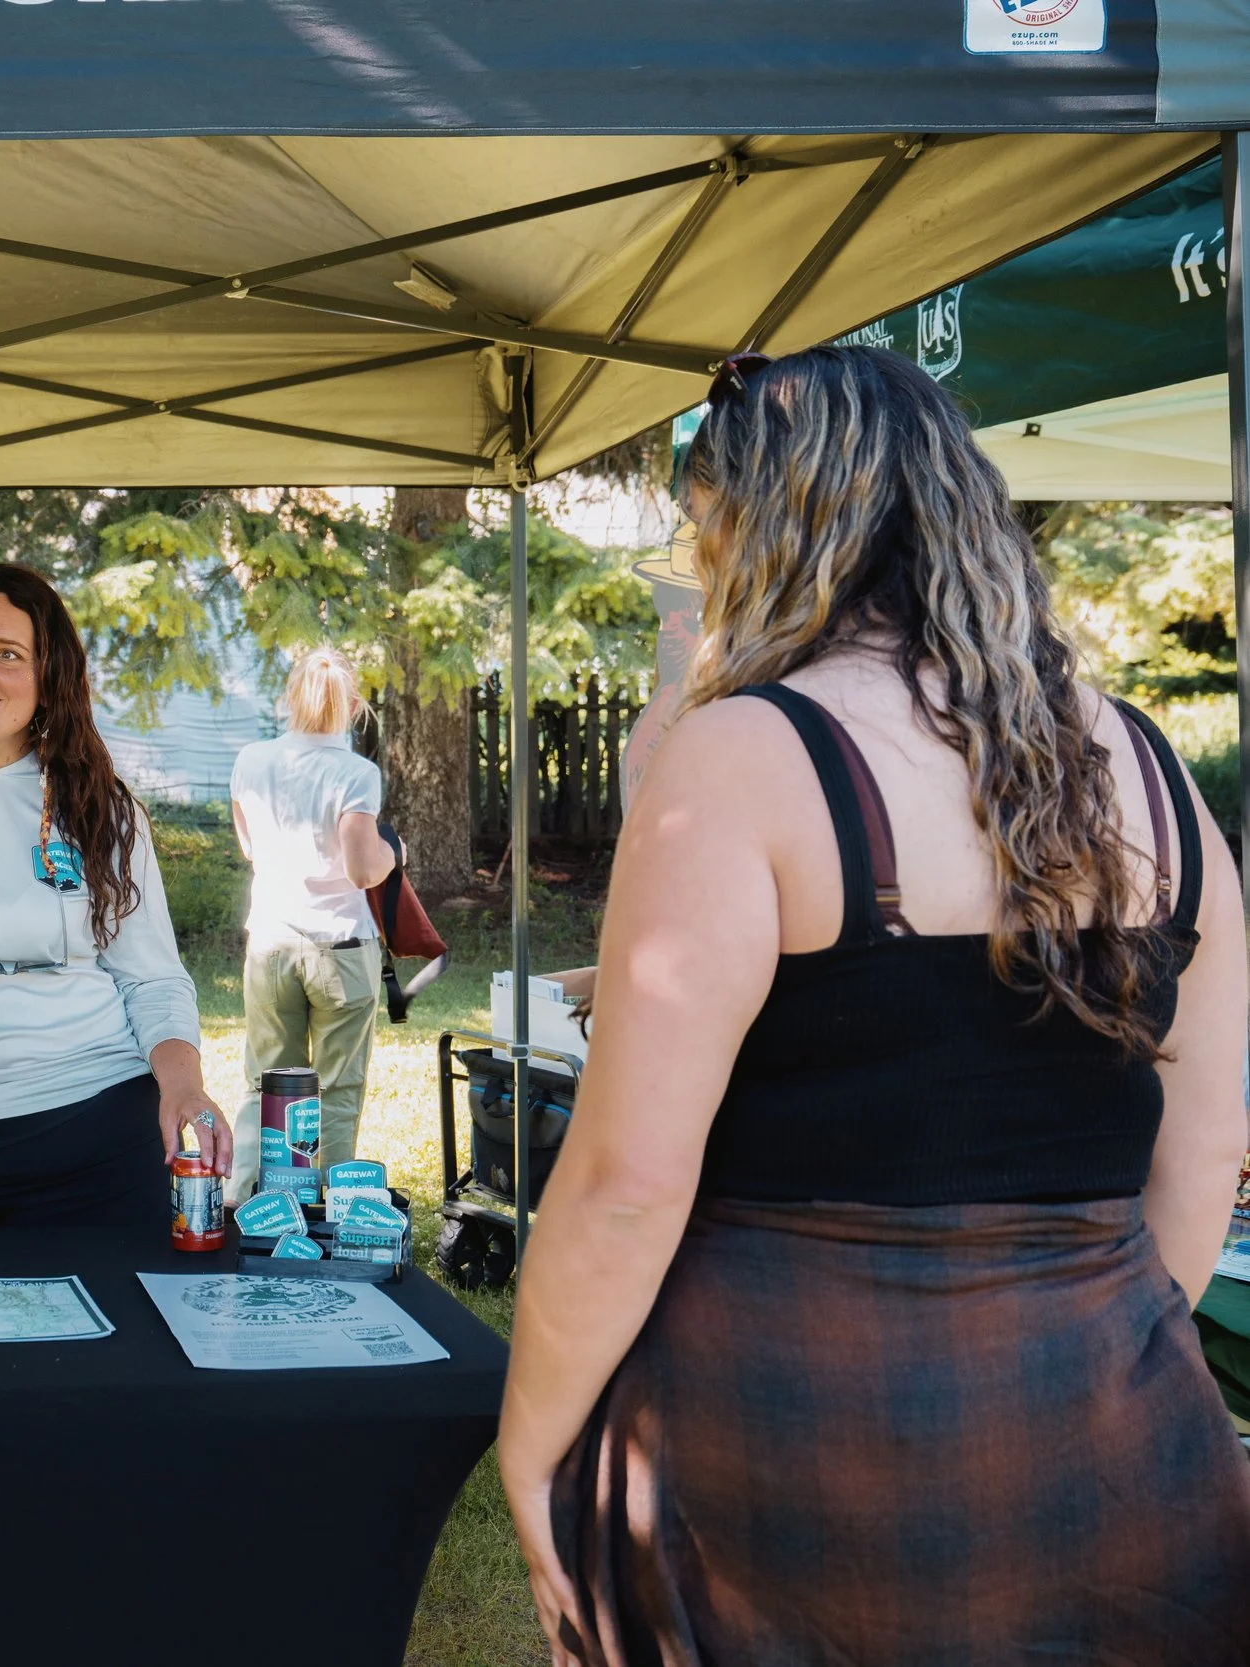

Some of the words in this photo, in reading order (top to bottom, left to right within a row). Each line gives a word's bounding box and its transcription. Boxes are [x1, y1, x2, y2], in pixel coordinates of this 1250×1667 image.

[1025, 9, 1064, 22] ORIGINAL
[1011, 32, 1059, 40] ezup.com
[39, 850, 76, 861] ATEWAY
[295, 1109, 319, 1117] GATEW
[297, 1122, 319, 1130] GLACIE
[261, 1150, 283, 1158] LACIER
[264, 1171, 317, 1186] Support
[337, 1170, 378, 1179] GATEWAY
[244, 1199, 281, 1220] GATEWAY
[358, 1204, 396, 1228] GATEWAY
[252, 1212, 285, 1231] GLACIER
[338, 1230, 393, 1247] Support
[291, 1239, 316, 1254] GATEWAY
[337, 1245, 370, 1259] local
[289, 1304, 347, 1319] TROT
[245, 1320, 291, 1328] August
